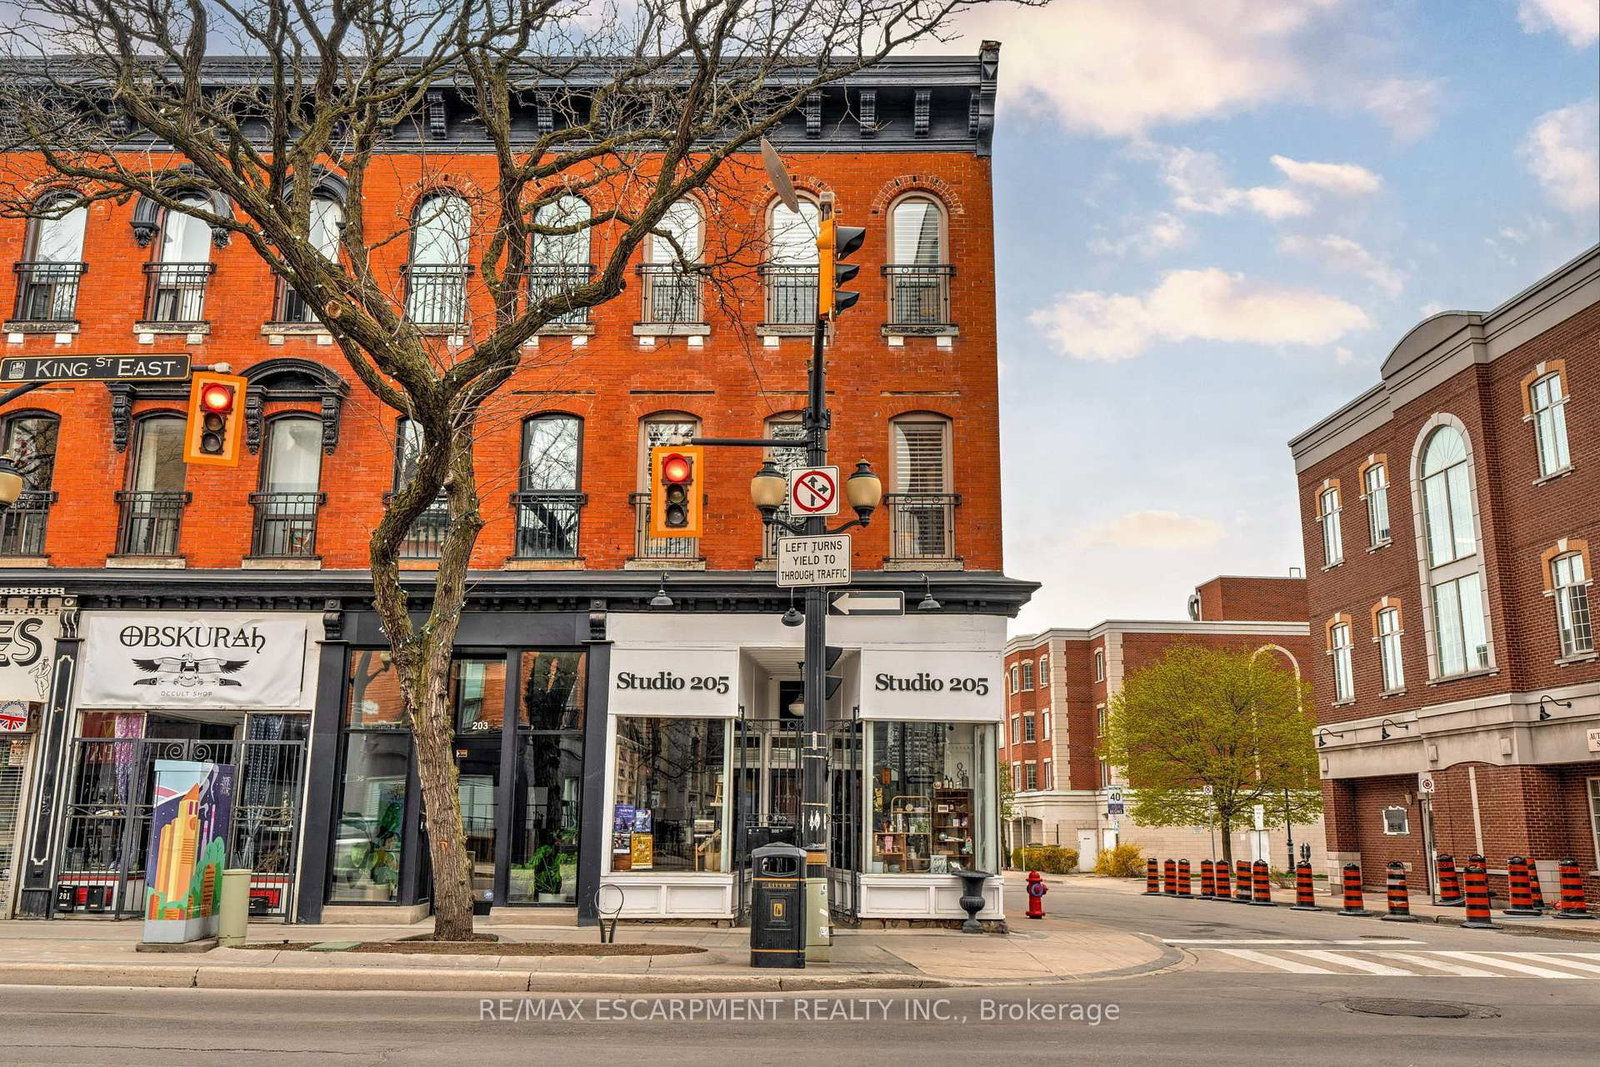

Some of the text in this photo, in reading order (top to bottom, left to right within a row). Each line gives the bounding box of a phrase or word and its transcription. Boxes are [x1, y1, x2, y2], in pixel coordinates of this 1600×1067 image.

[35, 360, 88, 377] KING
[117, 359, 176, 376] EAST
[785, 540, 843, 552] LEFT TURNS
[793, 554, 836, 566] YIELD TO
[781, 568, 847, 580] THROUGH TRAFFIC
[616, 671, 730, 694] Studio 205
[875, 673, 989, 696] Studio 205
[472, 722, 489, 730] 203
[1110, 792, 1120, 801] 40
